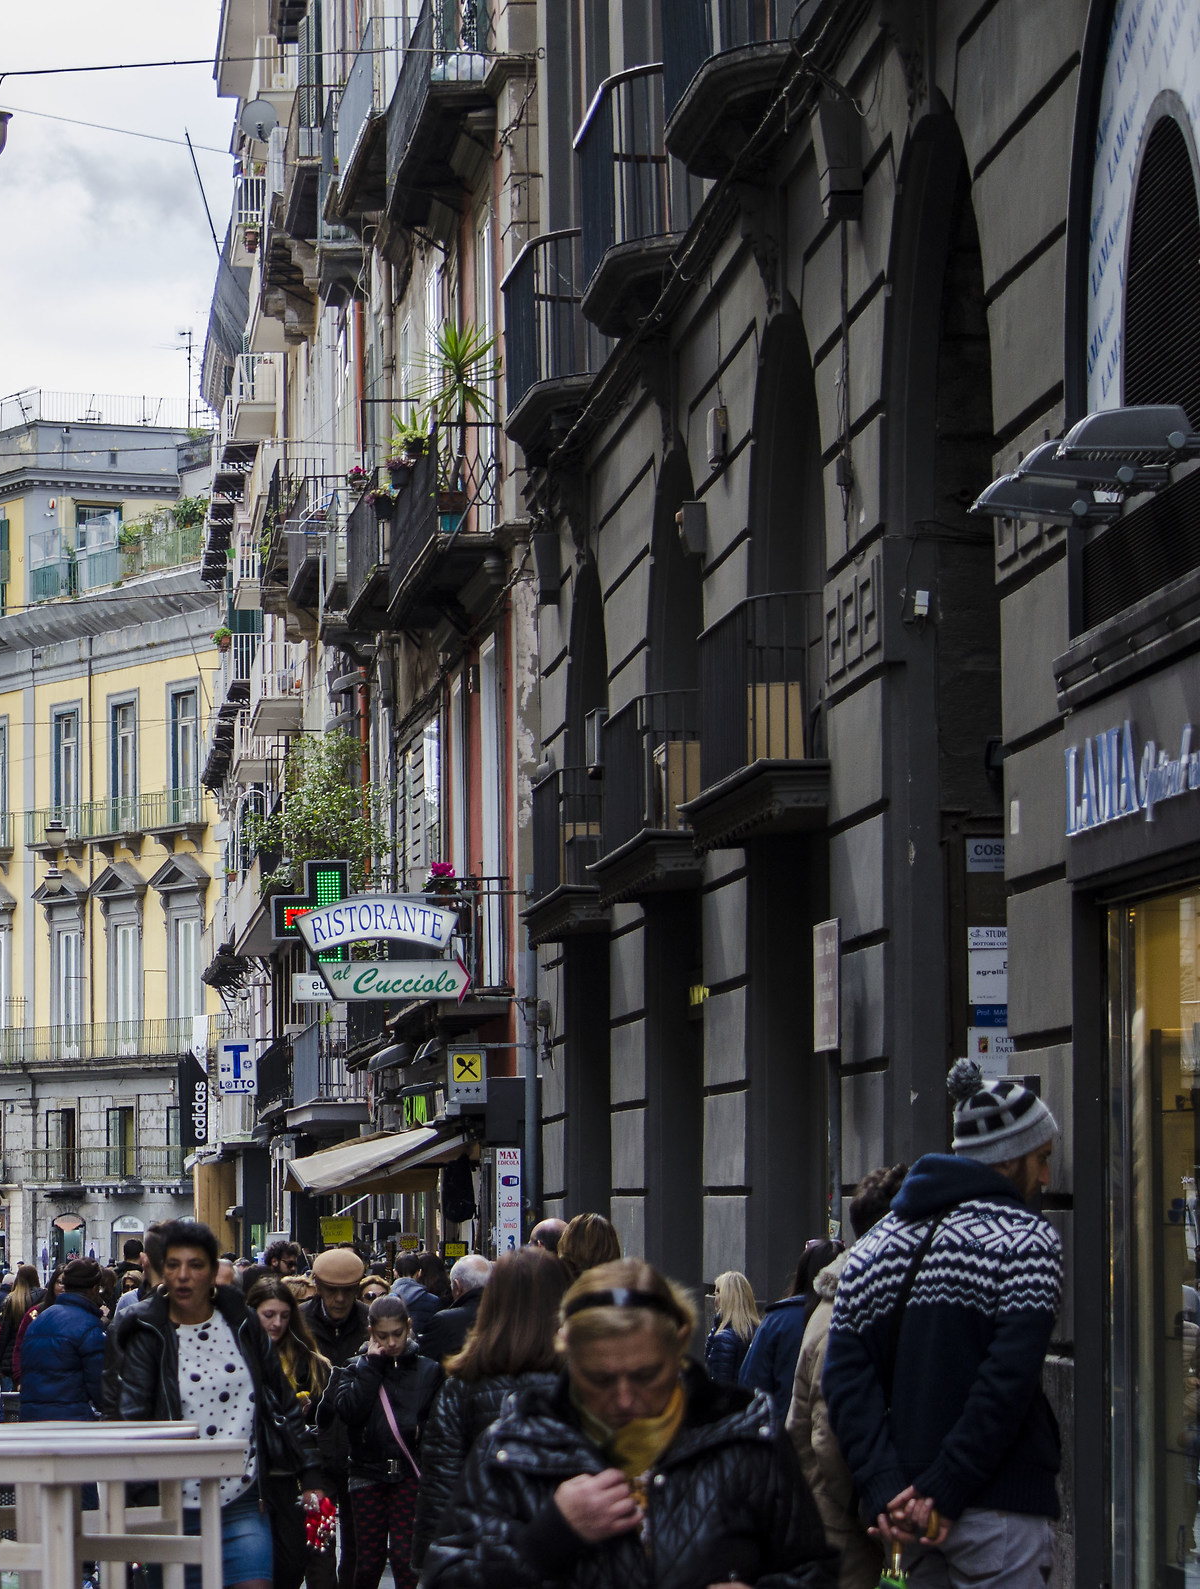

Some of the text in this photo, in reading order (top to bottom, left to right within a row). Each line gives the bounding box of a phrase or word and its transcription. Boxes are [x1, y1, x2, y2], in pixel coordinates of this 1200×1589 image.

[1064, 719, 1140, 837] LAMA
[311, 903, 444, 945] RISTORANTE
[332, 964, 459, 995] al Cucciolo
[191, 1081, 207, 1140] adidas
[499, 1150, 518, 1160] MAX
